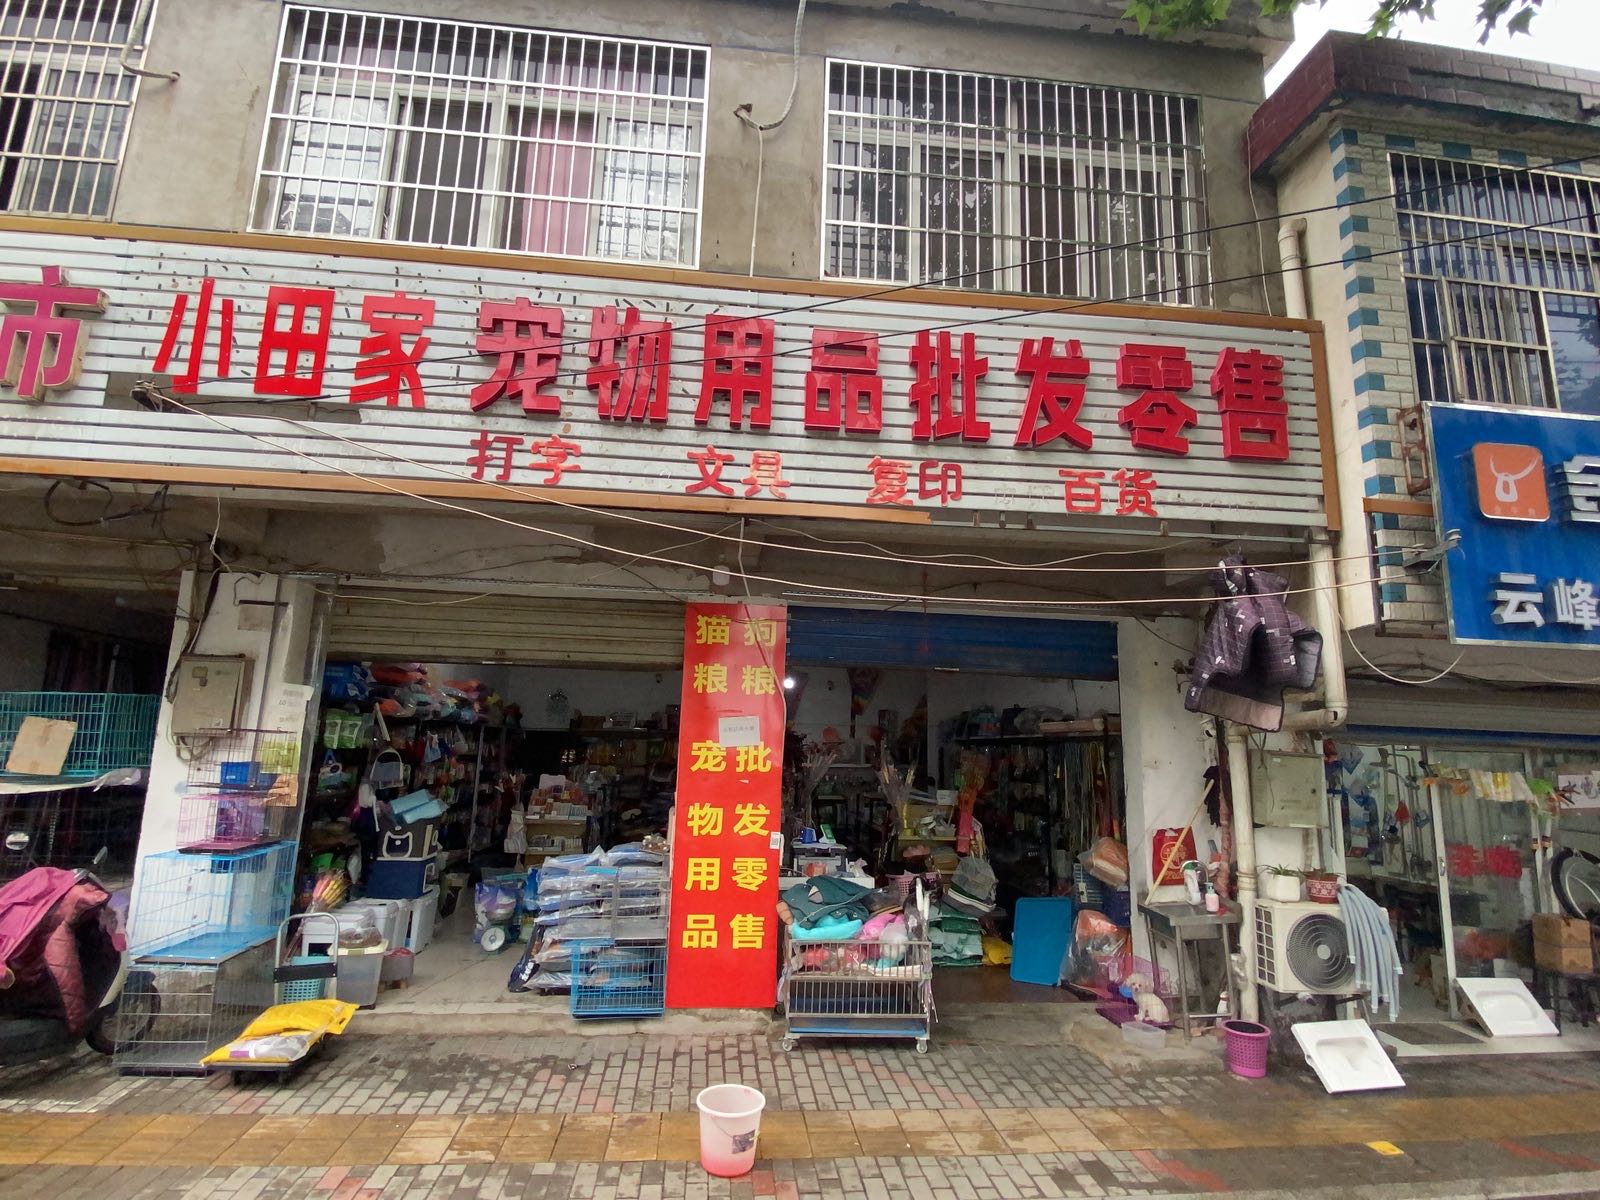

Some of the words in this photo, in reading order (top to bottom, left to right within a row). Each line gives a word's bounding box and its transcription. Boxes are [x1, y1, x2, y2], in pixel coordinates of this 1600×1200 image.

[0, 265, 106, 401] 市
[153, 277, 1290, 462] 小田家宠物用品批发零售
[468, 430, 582, 489] 打字
[685, 446, 790, 501] 文具
[866, 456, 965, 510] 复印
[1058, 467, 1160, 519] 百货
[694, 615, 734, 696] 猫粮
[740, 617, 778, 697] 狗粮
[1492, 571, 1600, 631] 云峰
[682, 739, 729, 950] 宠物用品
[729, 742, 774, 950] 批发零售
